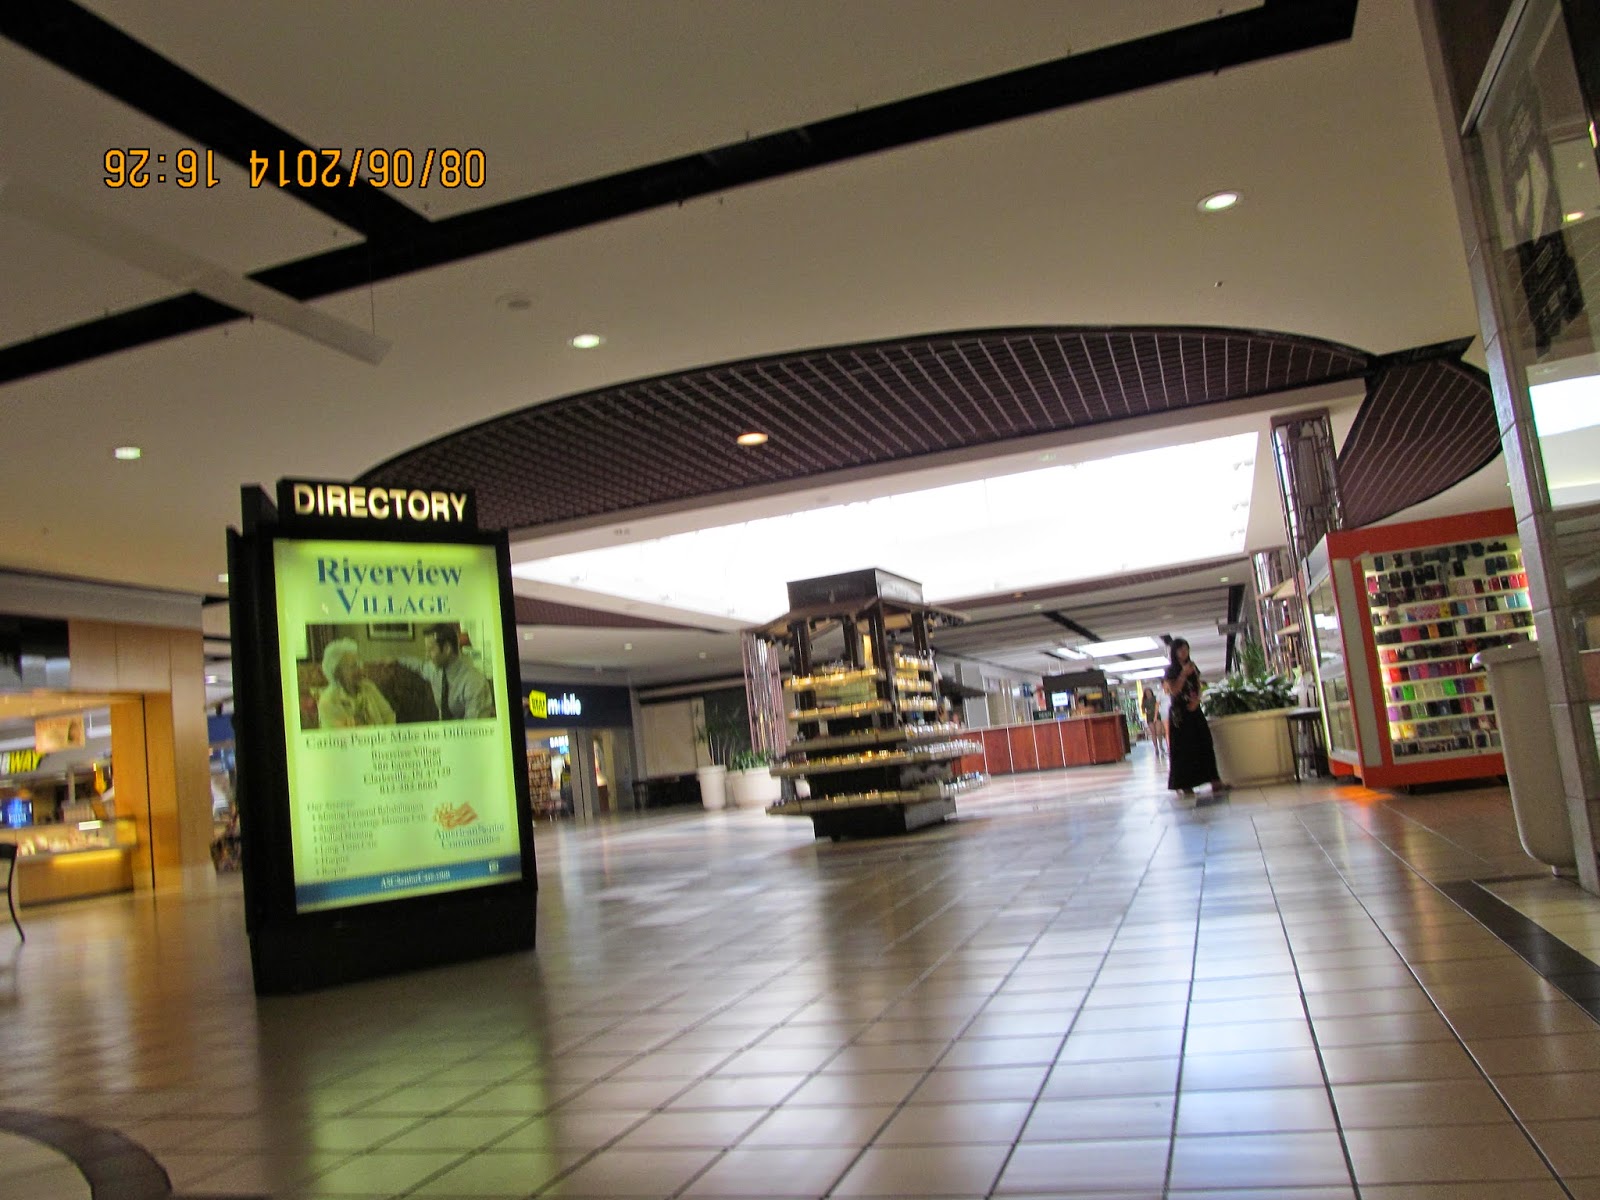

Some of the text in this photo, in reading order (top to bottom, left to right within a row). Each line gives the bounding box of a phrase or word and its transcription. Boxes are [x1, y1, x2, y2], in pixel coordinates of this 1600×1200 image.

[292, 483, 468, 522] DIRECTORY
[317, 557, 462, 586] Riverview
[336, 587, 451, 615] VILLAGE
